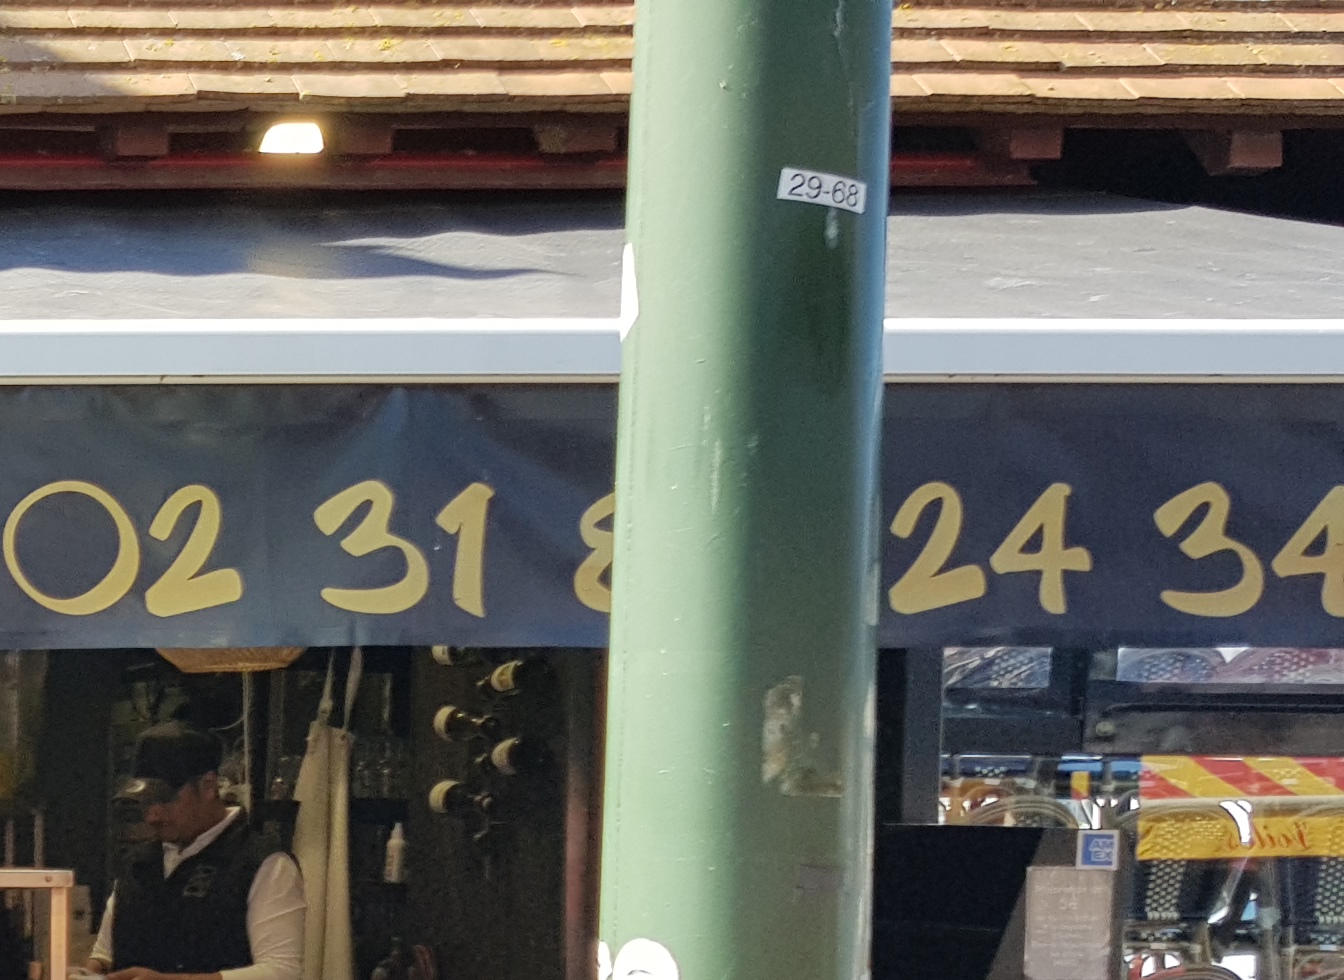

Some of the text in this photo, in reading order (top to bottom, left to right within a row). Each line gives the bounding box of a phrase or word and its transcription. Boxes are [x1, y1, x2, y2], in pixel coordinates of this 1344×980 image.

[788, 173, 859, 207] 29-68
[3, 480, 243, 616] 02
[314, 480, 496, 616] 31
[889, 481, 1093, 615] 24
[1154, 480, 1344, 616] 34
